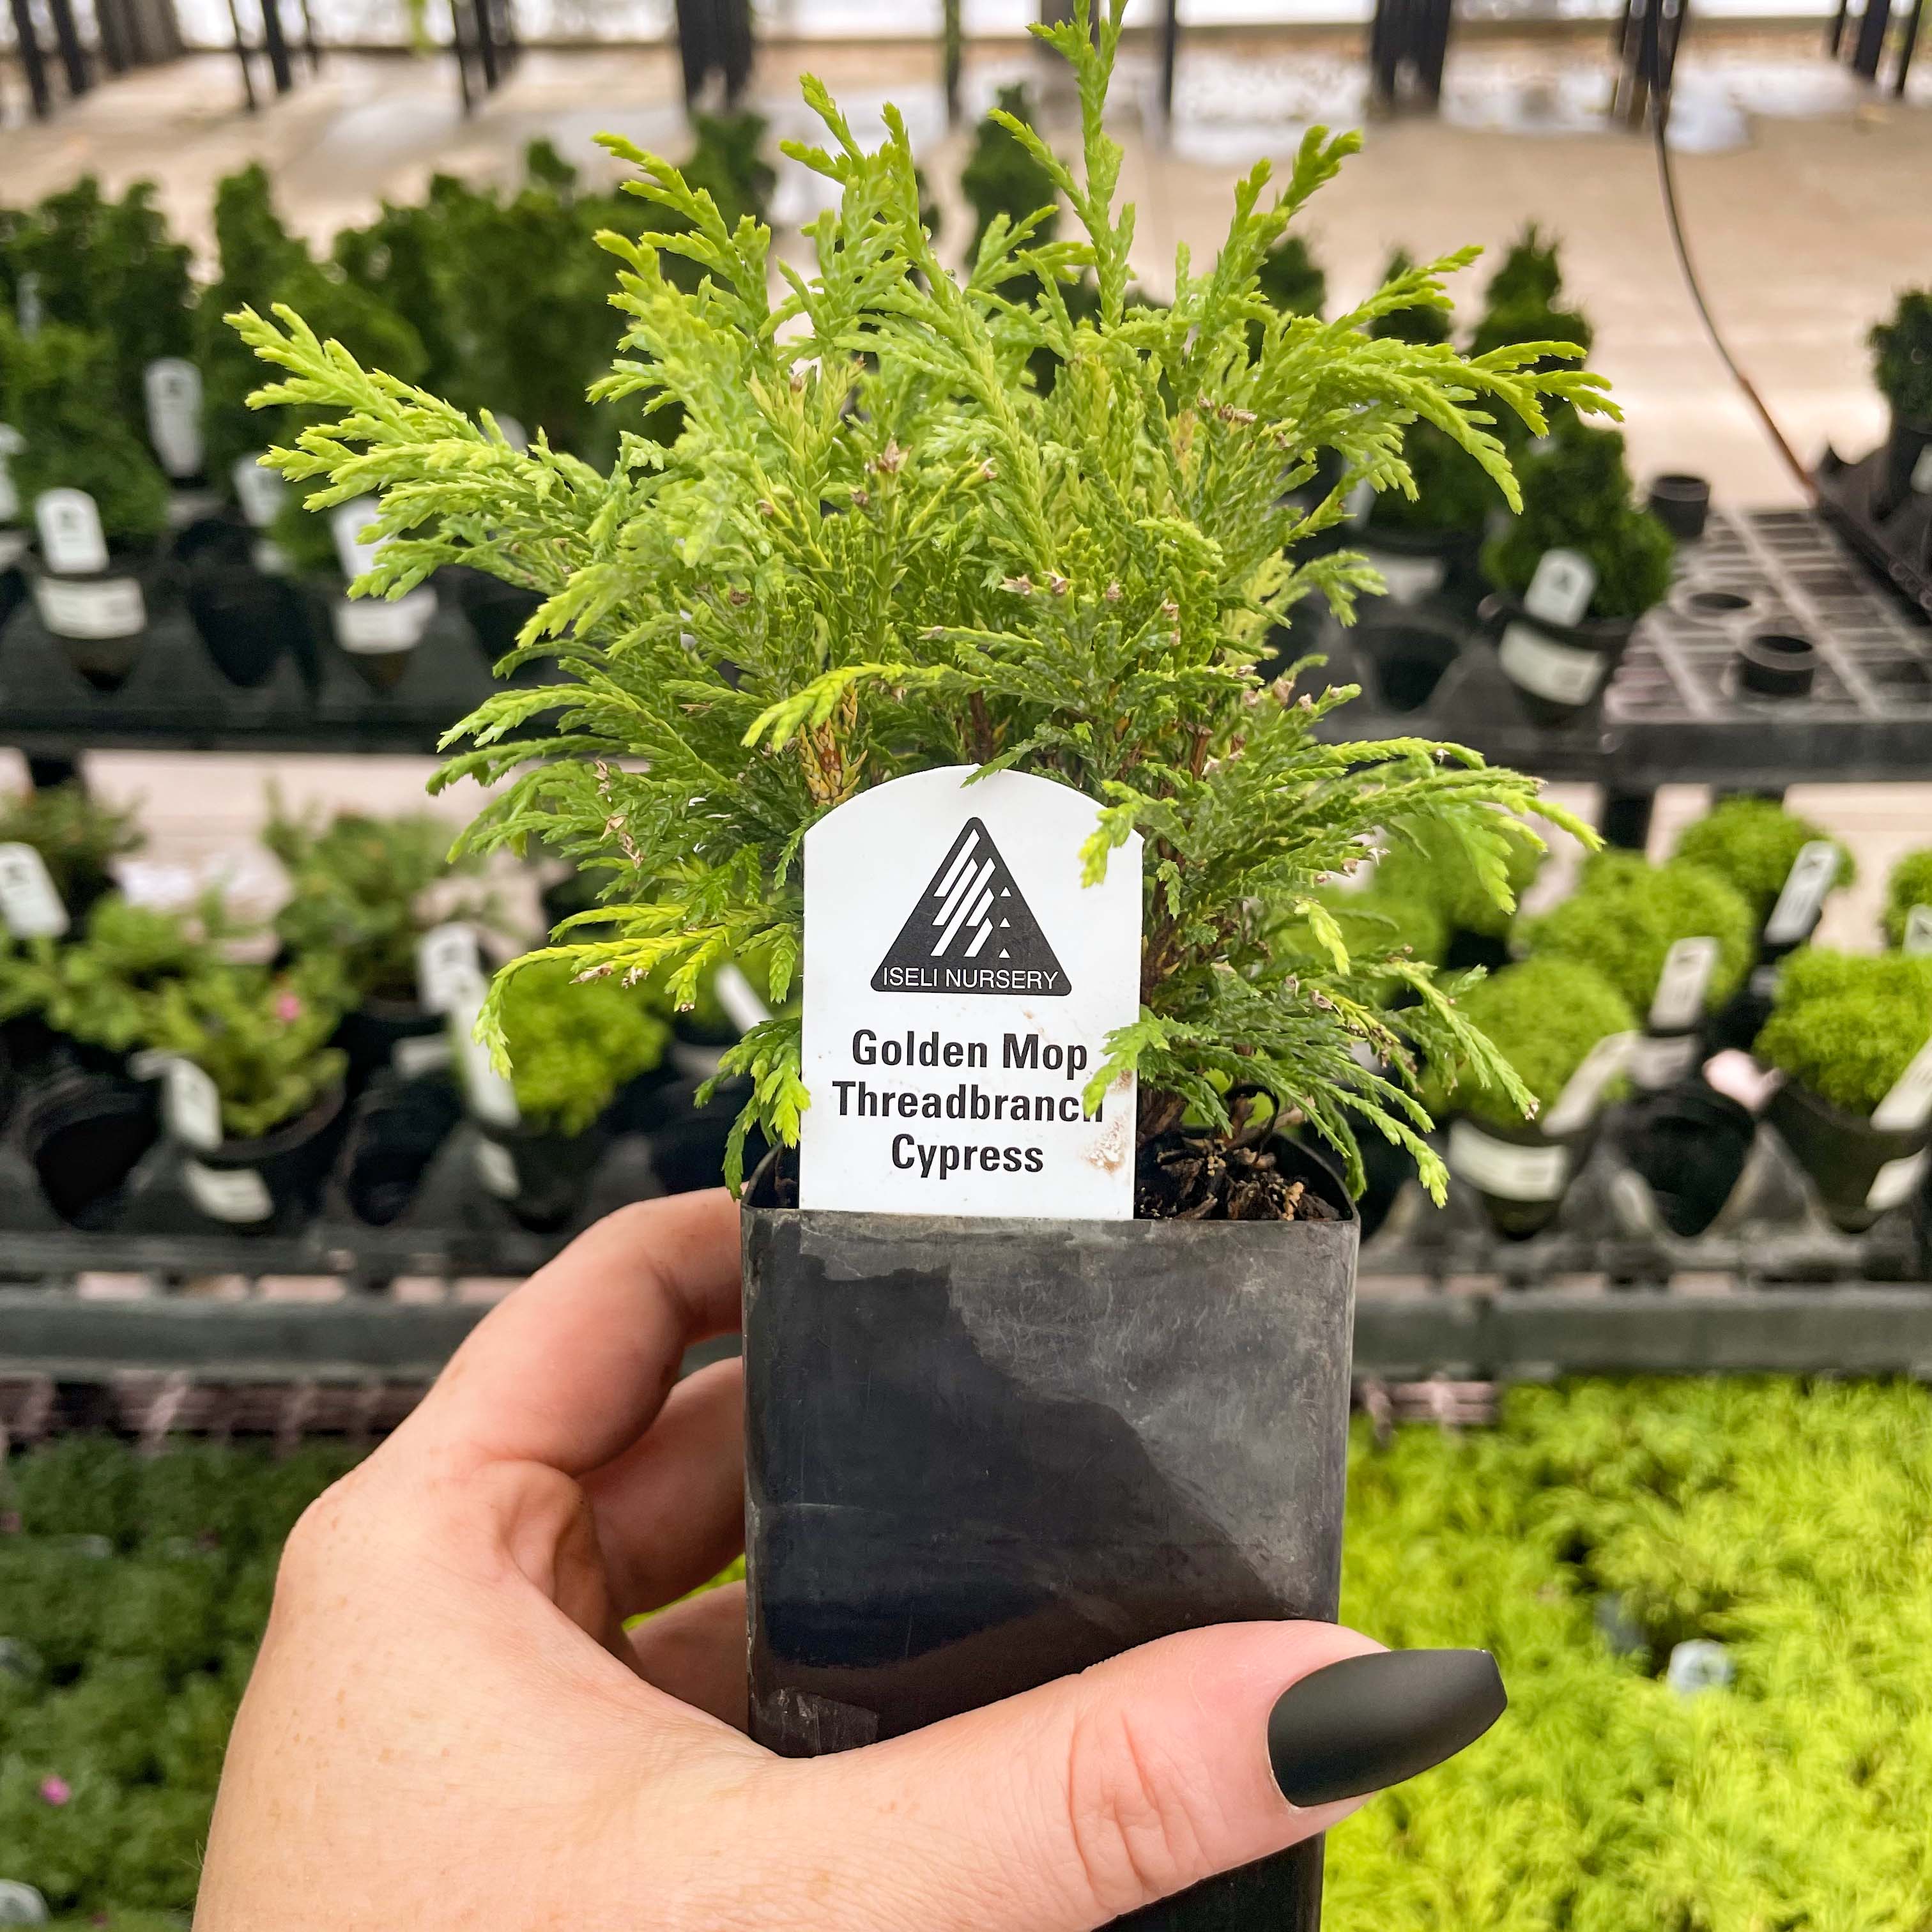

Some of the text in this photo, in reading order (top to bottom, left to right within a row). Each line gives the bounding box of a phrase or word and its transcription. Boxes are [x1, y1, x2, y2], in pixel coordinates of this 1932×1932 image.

[884, 967, 1059, 990] ISELI NURSERY
[852, 1029, 1087, 1080] Golden Mop
[892, 1133, 1043, 1180] Cypress
